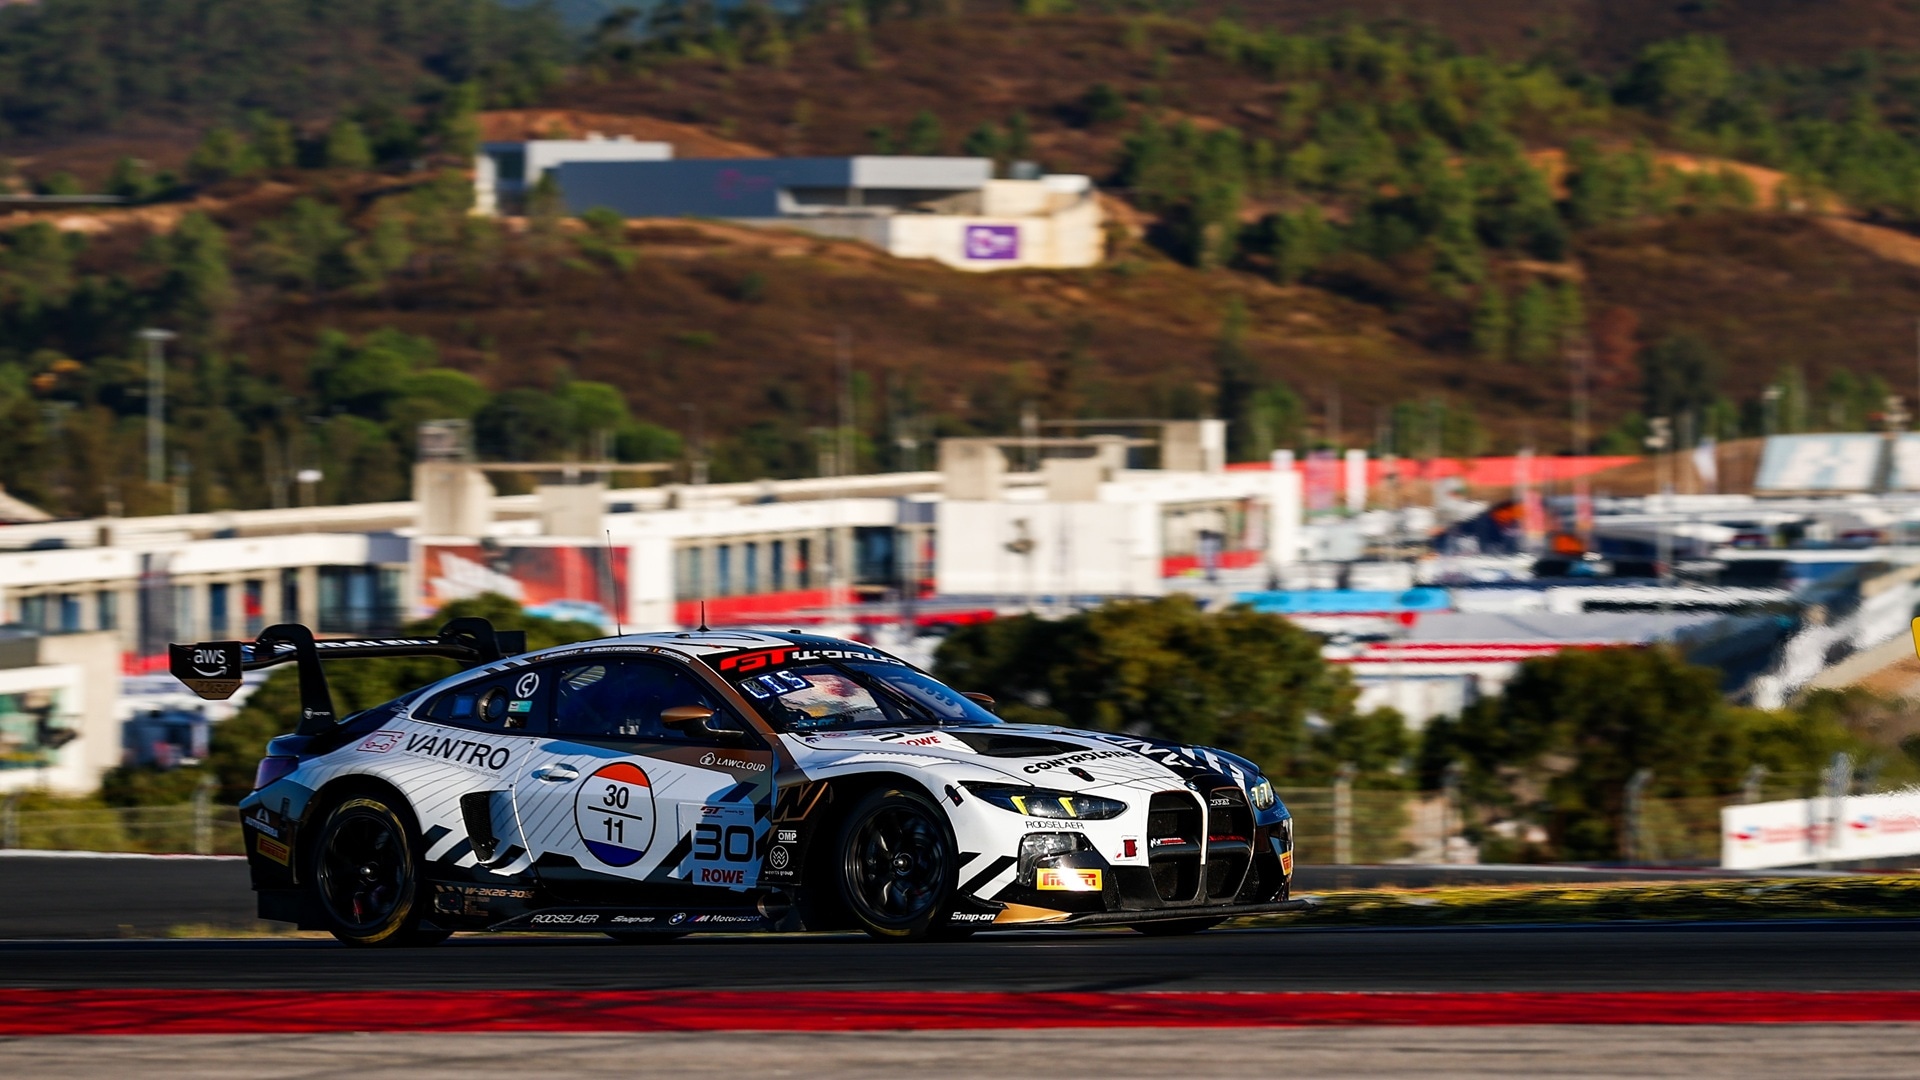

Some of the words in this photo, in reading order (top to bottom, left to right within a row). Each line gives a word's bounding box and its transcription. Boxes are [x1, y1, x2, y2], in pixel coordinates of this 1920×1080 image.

[193, 649, 226, 664] aws
[720, 647, 800, 672] GT
[741, 670, 806, 699] LIS
[897, 736, 941, 747] OWE
[405, 733, 510, 771] VANTRO
[716, 757, 766, 772] LAWCLOUD
[603, 784, 630, 809] 30
[603, 816, 624, 844] 11
[1025, 821, 1085, 830] ROOSELAER
[694, 823, 754, 862] 30
[778, 832, 797, 841] OMP
[701, 868, 745, 884] ROWE
[530, 914, 599, 923] ROOSELAER
[951, 911, 996, 922] Snap-on
